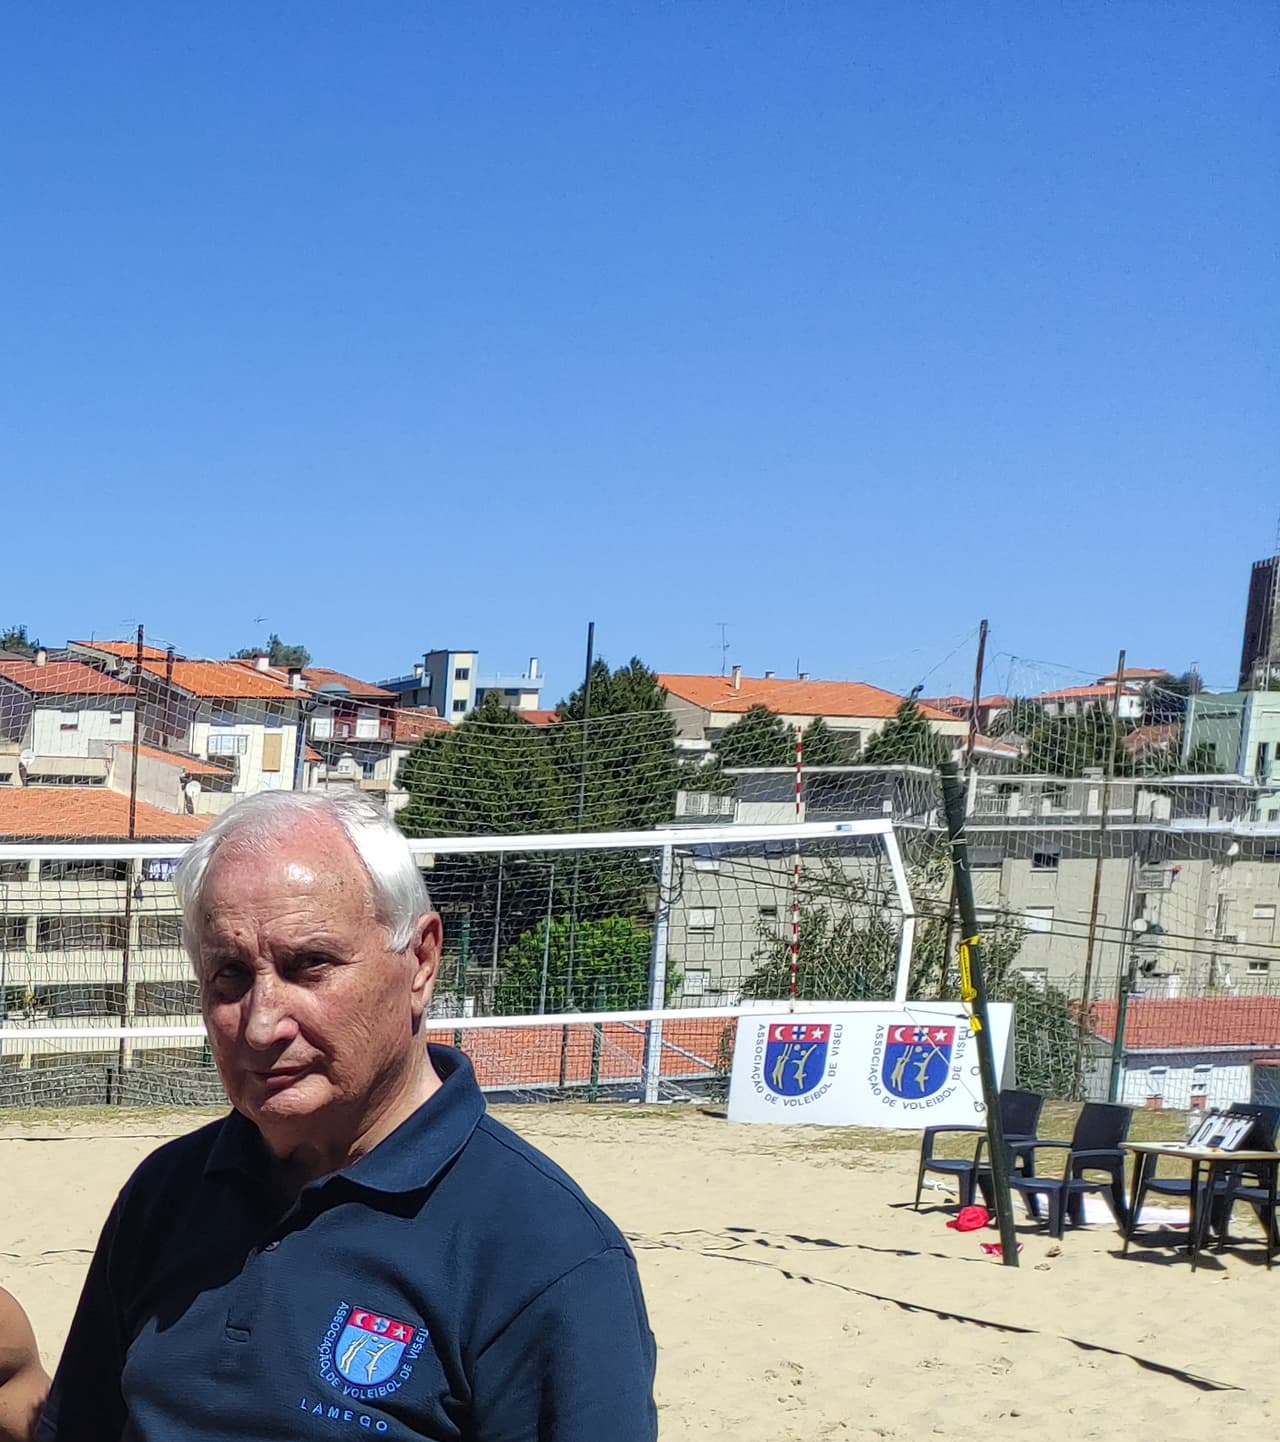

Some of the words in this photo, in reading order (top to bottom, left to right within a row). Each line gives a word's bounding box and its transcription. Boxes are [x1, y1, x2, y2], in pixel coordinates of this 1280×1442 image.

[764, 1093, 778, 1105] DE
[783, 1082, 833, 1107] VOLEIBOL
[827, 1062, 838, 1077] DE
[882, 1096, 897, 1108] DE
[902, 1085, 957, 1110] VOLEIBOL
[951, 1065, 962, 1081] DE
[325, 1371, 341, 1389] DE
[343, 1380, 402, 1399] VOLEIBOL
[400, 1362, 413, 1380] DE
[300, 1398, 389, 1432] LAMEGO
